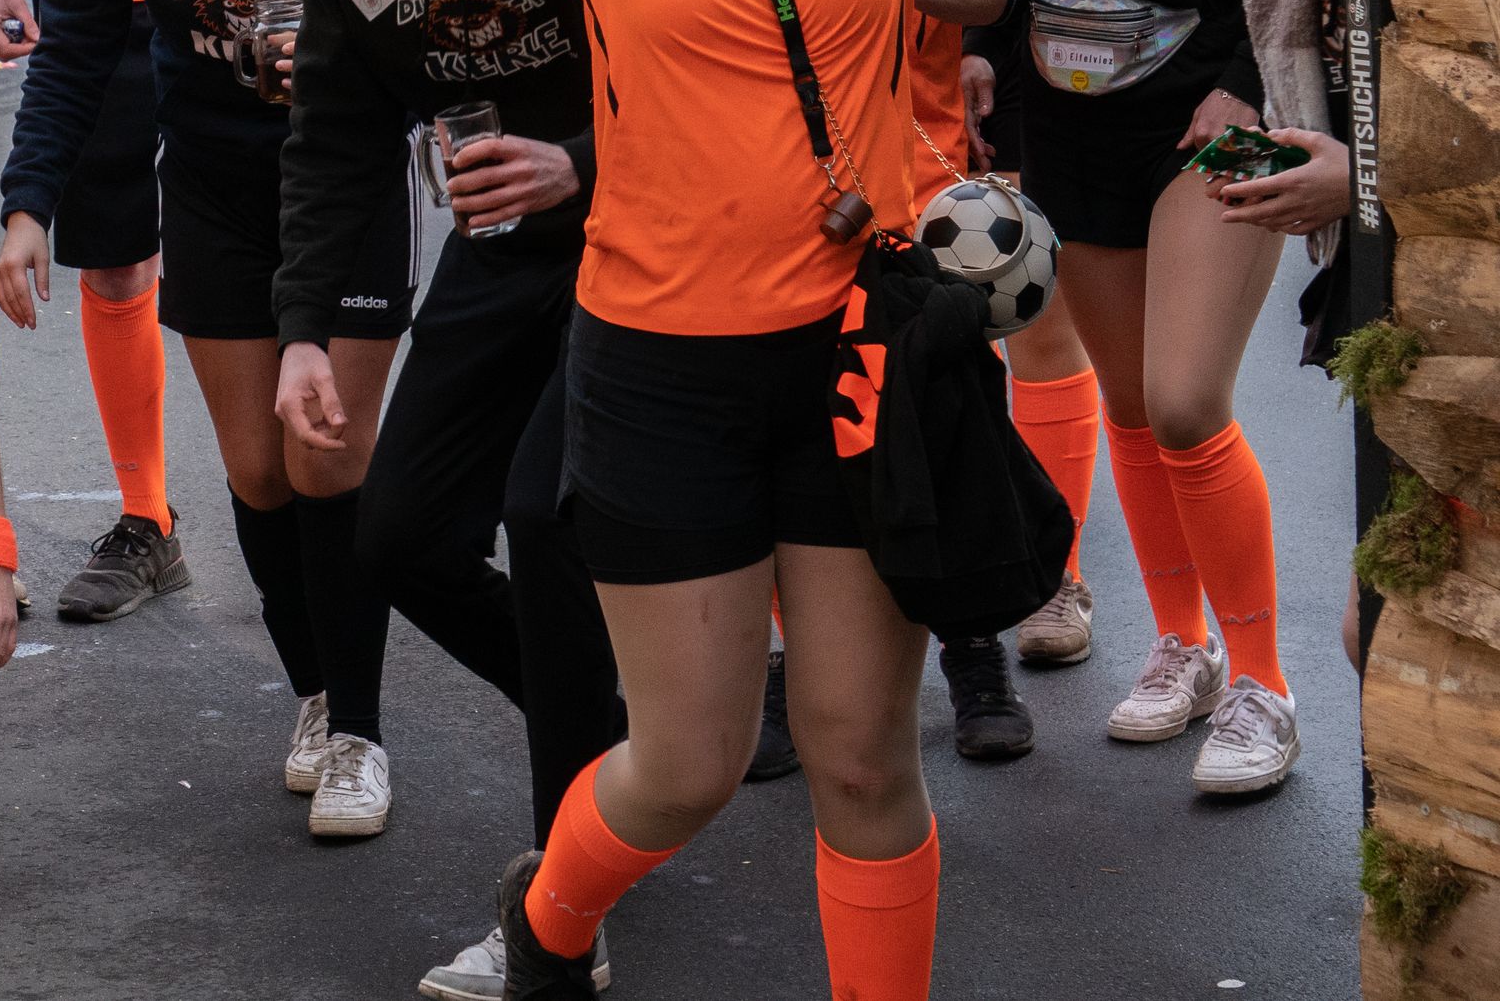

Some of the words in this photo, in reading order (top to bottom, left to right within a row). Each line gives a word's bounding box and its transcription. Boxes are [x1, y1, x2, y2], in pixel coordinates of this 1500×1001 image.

[425, 17, 571, 81] KERLE
[1350, 29, 1380, 229] #FETTSÜCHTIG
[341, 295, 388, 309] adidas
